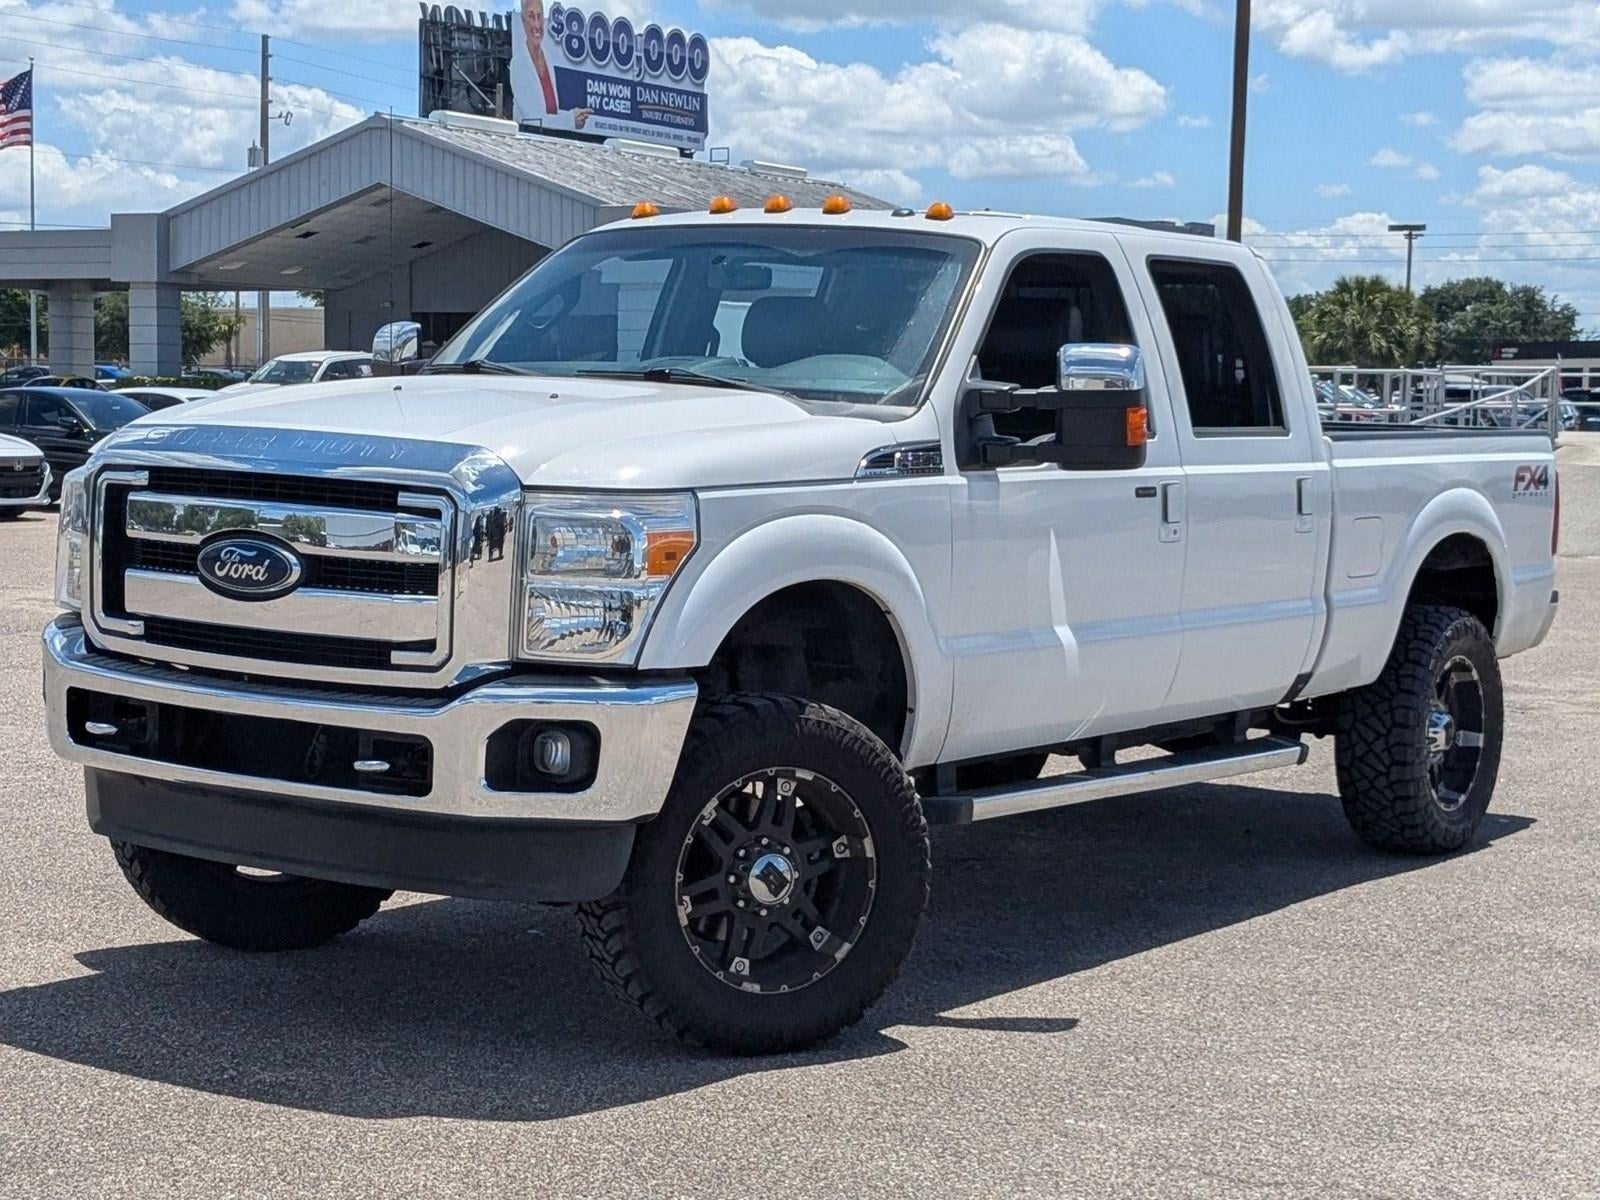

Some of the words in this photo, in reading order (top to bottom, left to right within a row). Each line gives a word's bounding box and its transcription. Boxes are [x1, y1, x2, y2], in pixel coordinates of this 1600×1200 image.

[549, 2, 710, 84] $800,000
[586, 79, 607, 95] DAN
[608, 83, 631, 99] WON
[586, 95, 601, 109] MY
[636, 86, 659, 104] DAN
[660, 90, 700, 111] NEWLIN
[1512, 464, 1549, 491] FX4
[214, 546, 271, 581] Ford
